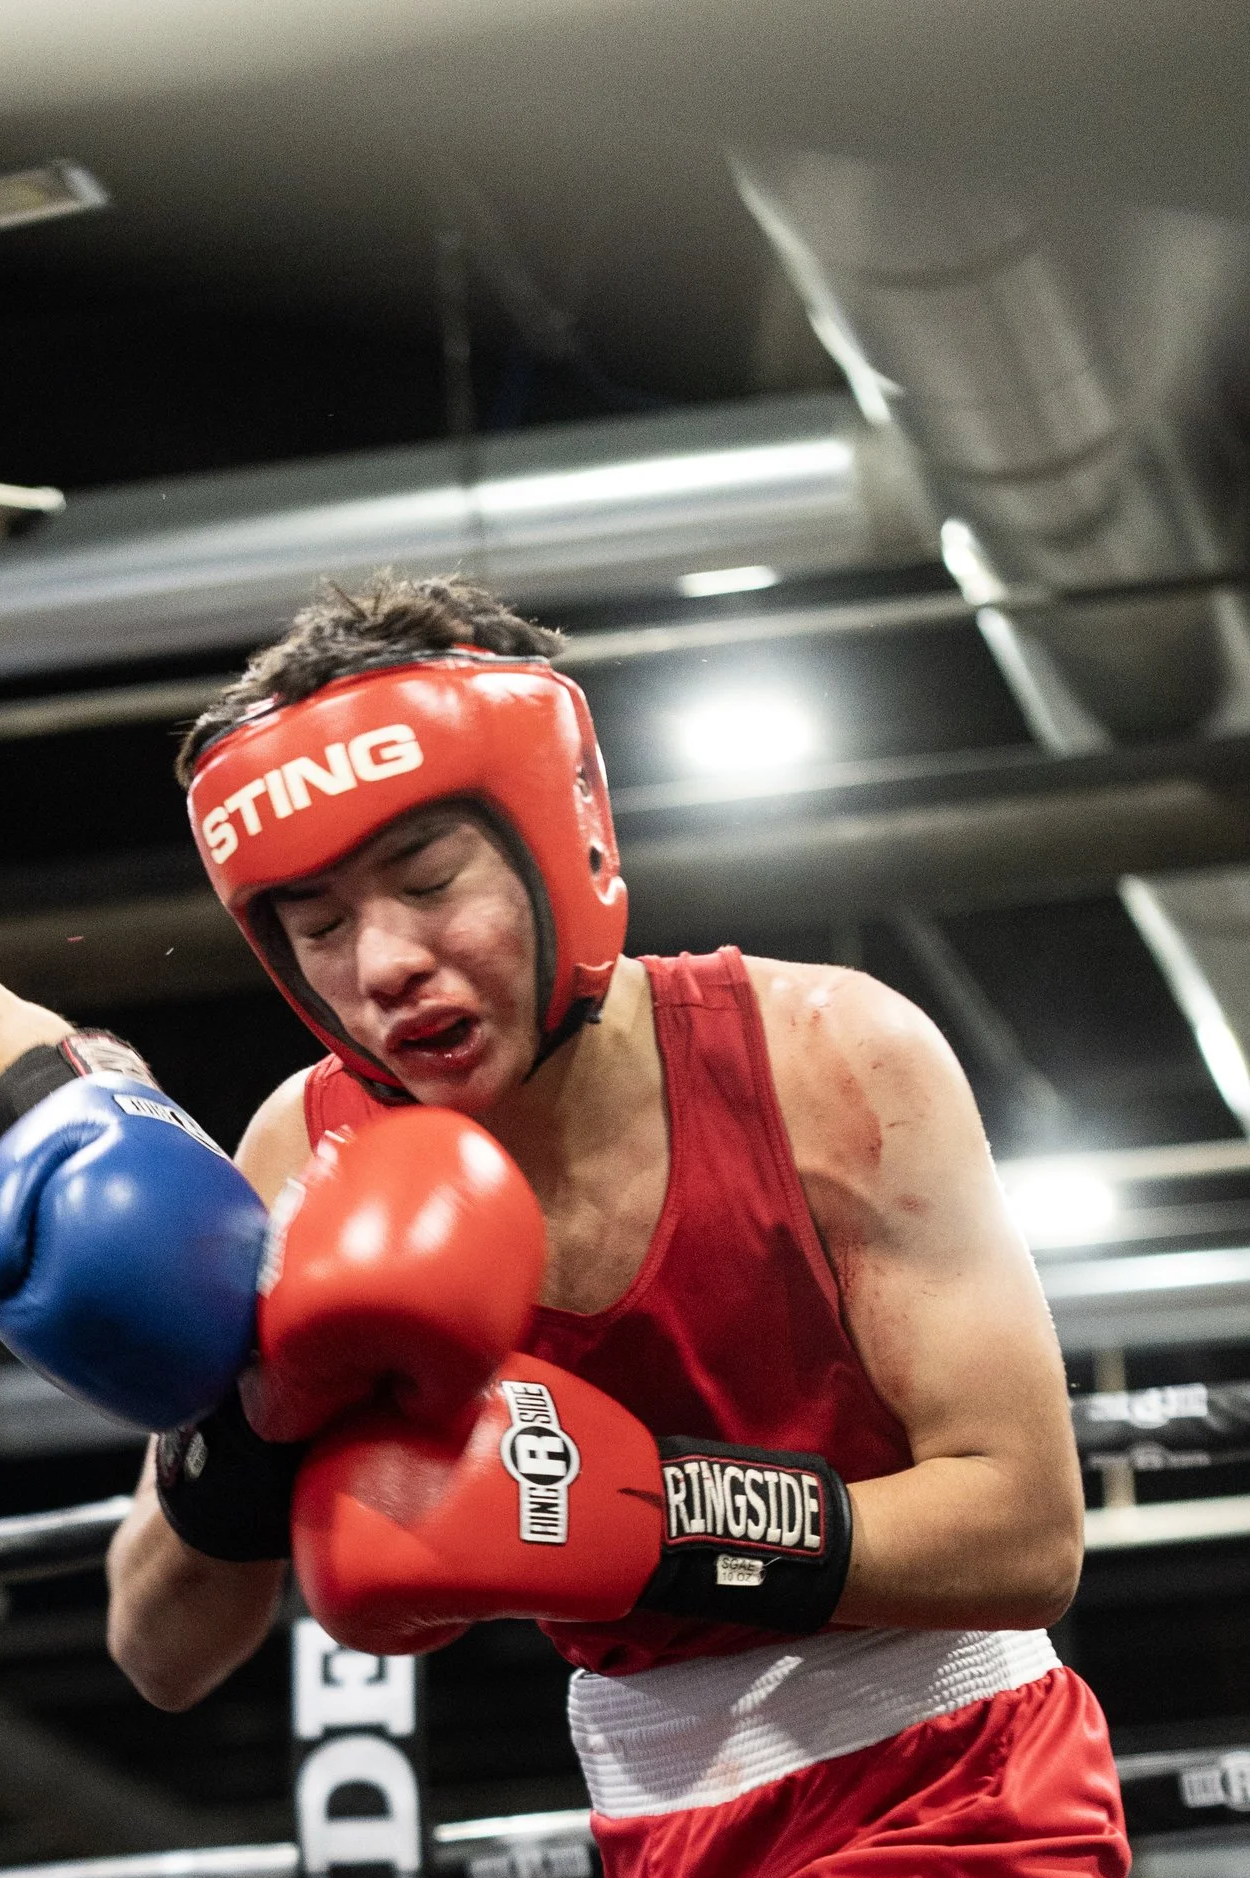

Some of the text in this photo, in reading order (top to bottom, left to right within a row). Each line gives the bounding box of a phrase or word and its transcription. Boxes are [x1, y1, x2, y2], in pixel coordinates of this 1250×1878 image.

[202, 724, 424, 865] STING
[510, 1386, 552, 1425] SIDE
[514, 1434, 567, 1477] R
[663, 1461, 821, 1549] RINGSIDE
